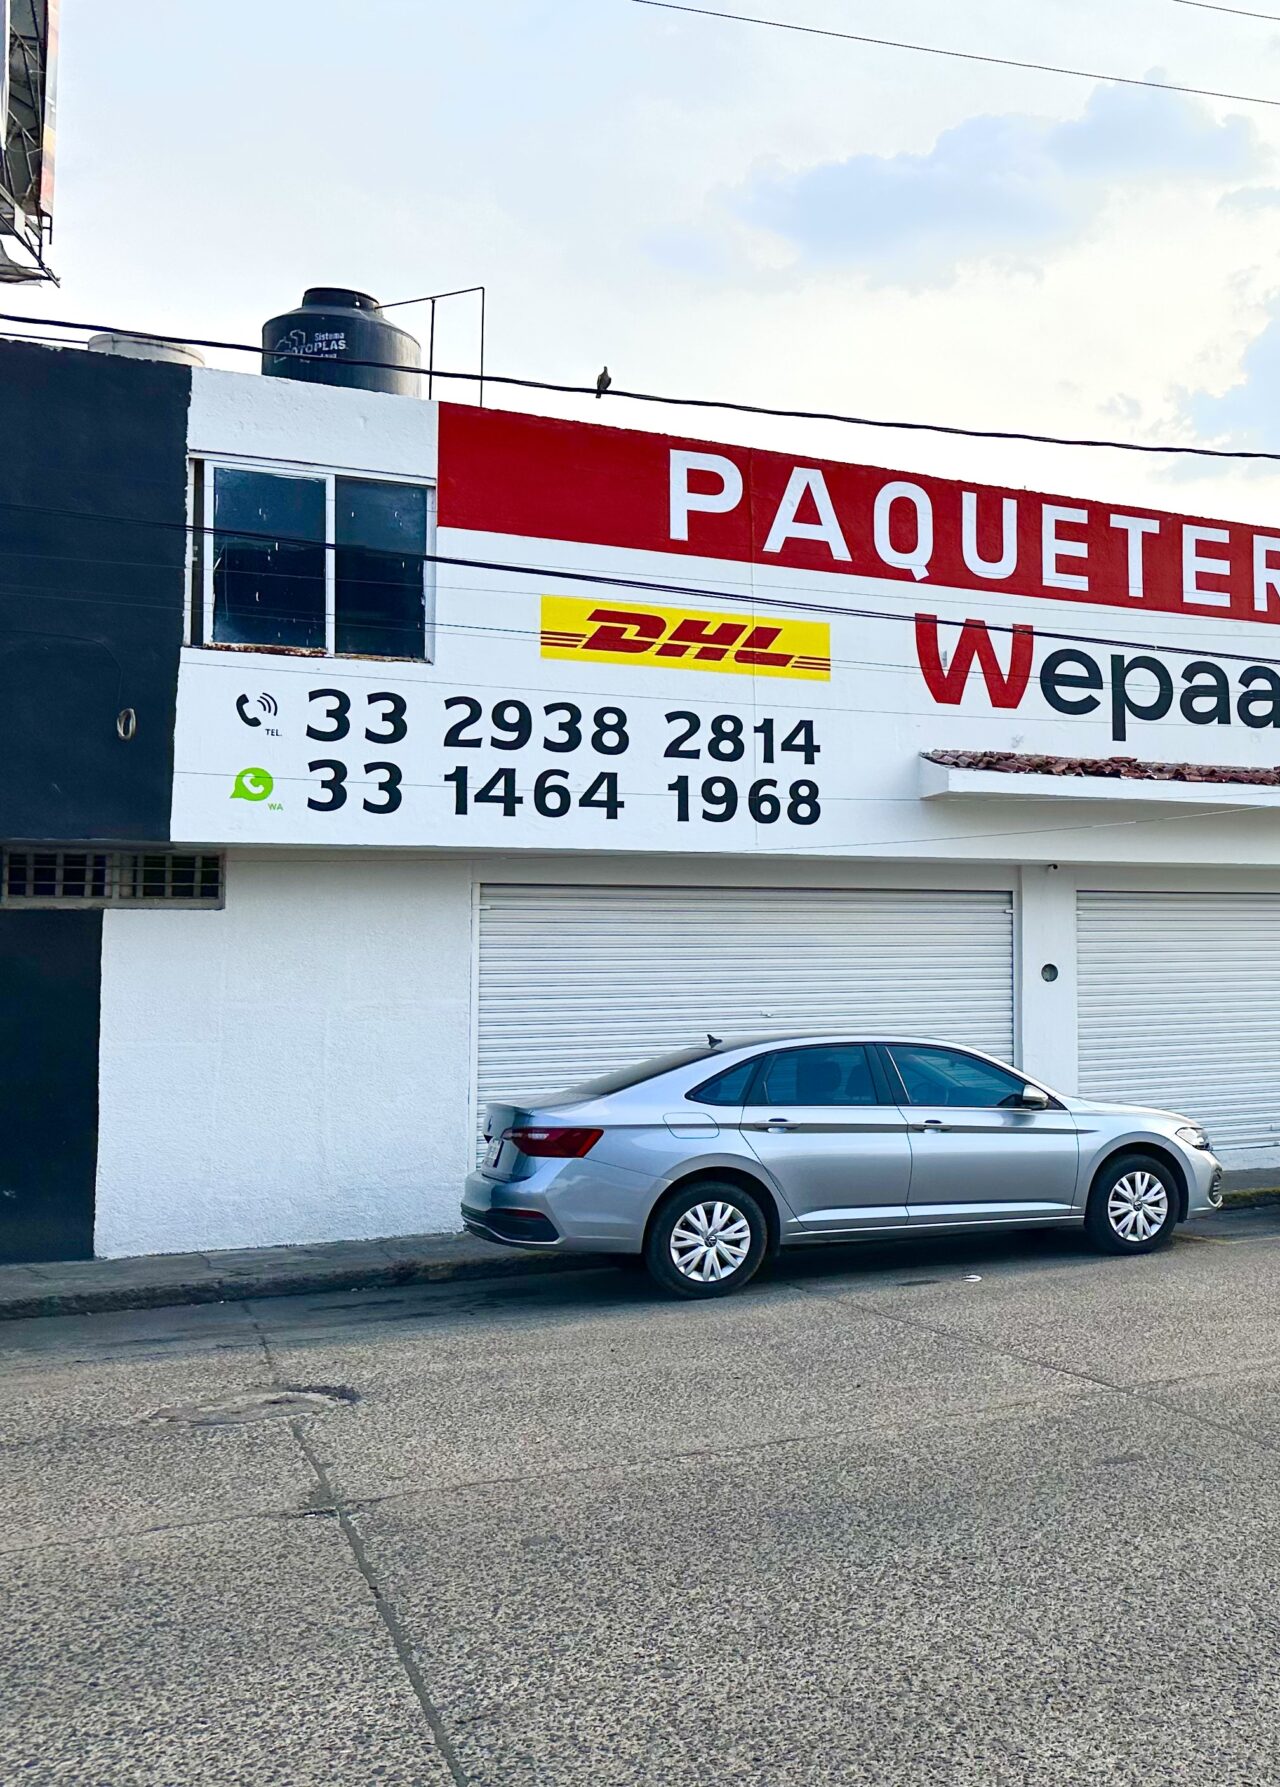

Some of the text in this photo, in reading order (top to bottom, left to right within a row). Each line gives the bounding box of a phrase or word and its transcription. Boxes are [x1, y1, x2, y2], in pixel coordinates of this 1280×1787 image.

[314, 332, 345, 341] Sistema
[581, 608, 796, 668] DHL
[305, 688, 821, 765] 33 2938 2814
[268, 803, 284, 811] WA
[307, 759, 821, 826] 33 1464 1968
